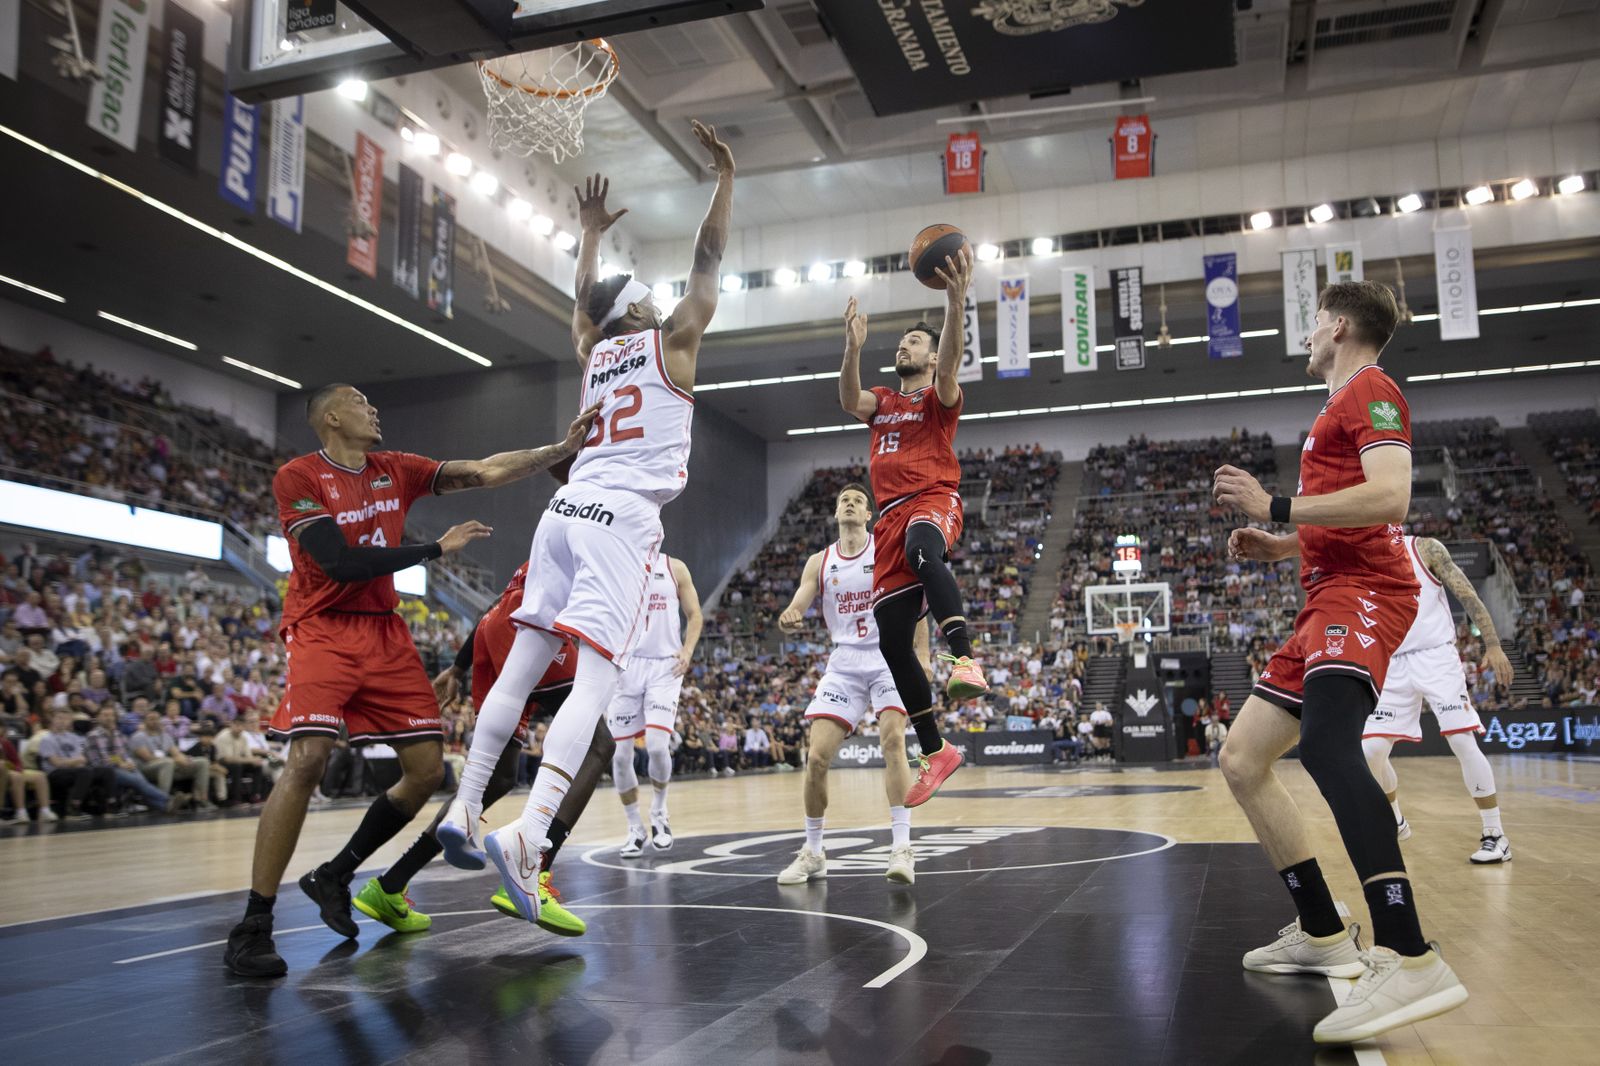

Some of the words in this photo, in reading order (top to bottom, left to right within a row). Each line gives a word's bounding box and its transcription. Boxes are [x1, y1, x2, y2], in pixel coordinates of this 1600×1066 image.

[288, 14, 335, 30] endesa
[100, 8, 137, 134] fertisac
[225, 97, 255, 201] PULE
[1127, 135, 1138, 153] 8
[955, 151, 971, 169] 18
[1441, 247, 1464, 320] niobio
[1128, 268, 1143, 330] BURGERS
[878, 431, 900, 455] 15
[1117, 547, 1136, 561] 15
[836, 590, 871, 603] Cultura
[1483, 716, 1558, 749] Agaz
